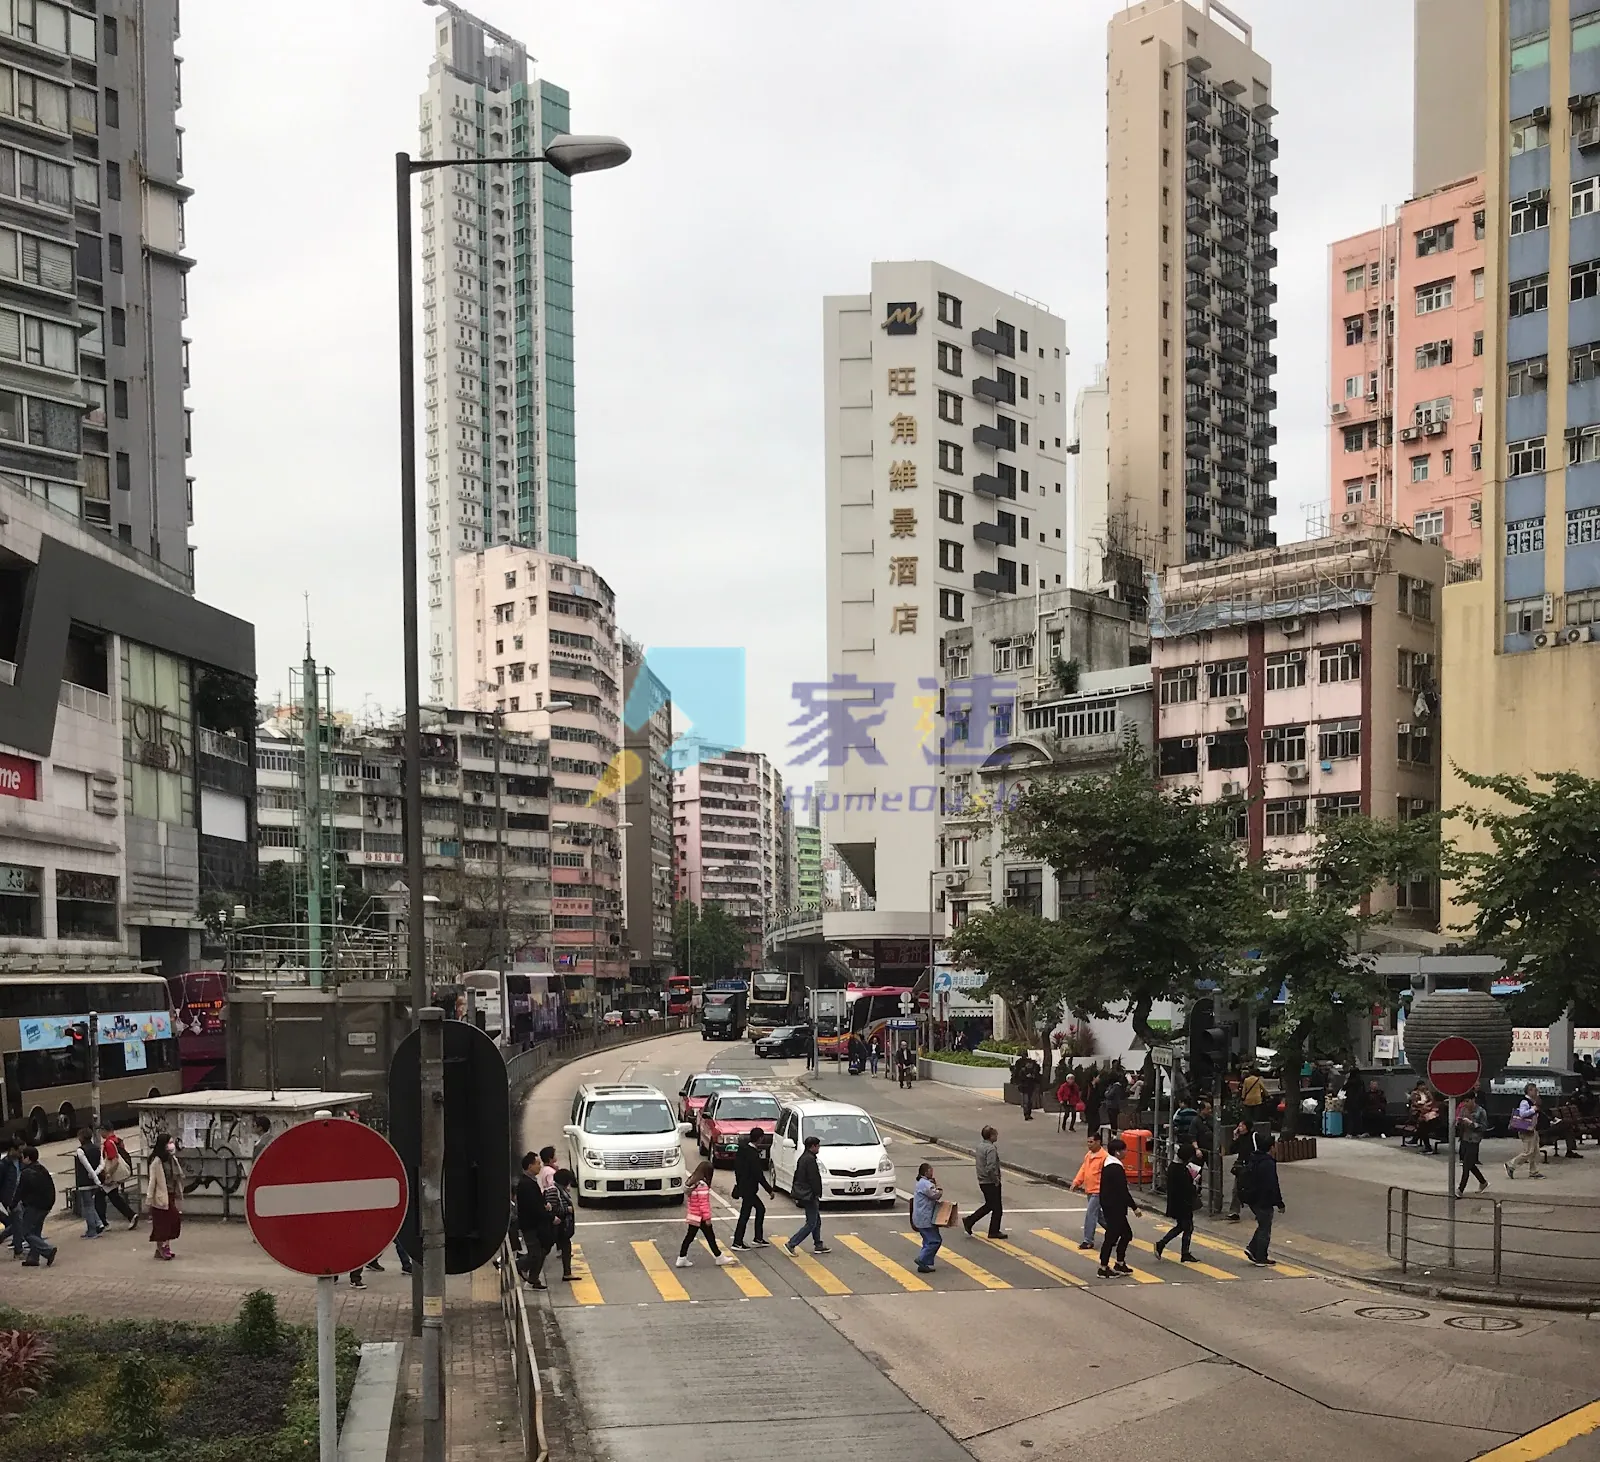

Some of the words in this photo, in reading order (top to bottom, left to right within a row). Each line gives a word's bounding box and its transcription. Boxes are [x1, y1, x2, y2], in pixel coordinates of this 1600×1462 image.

[888, 367, 919, 635] 旺角維景酒店
[1513, 520, 1539, 530] 1976
